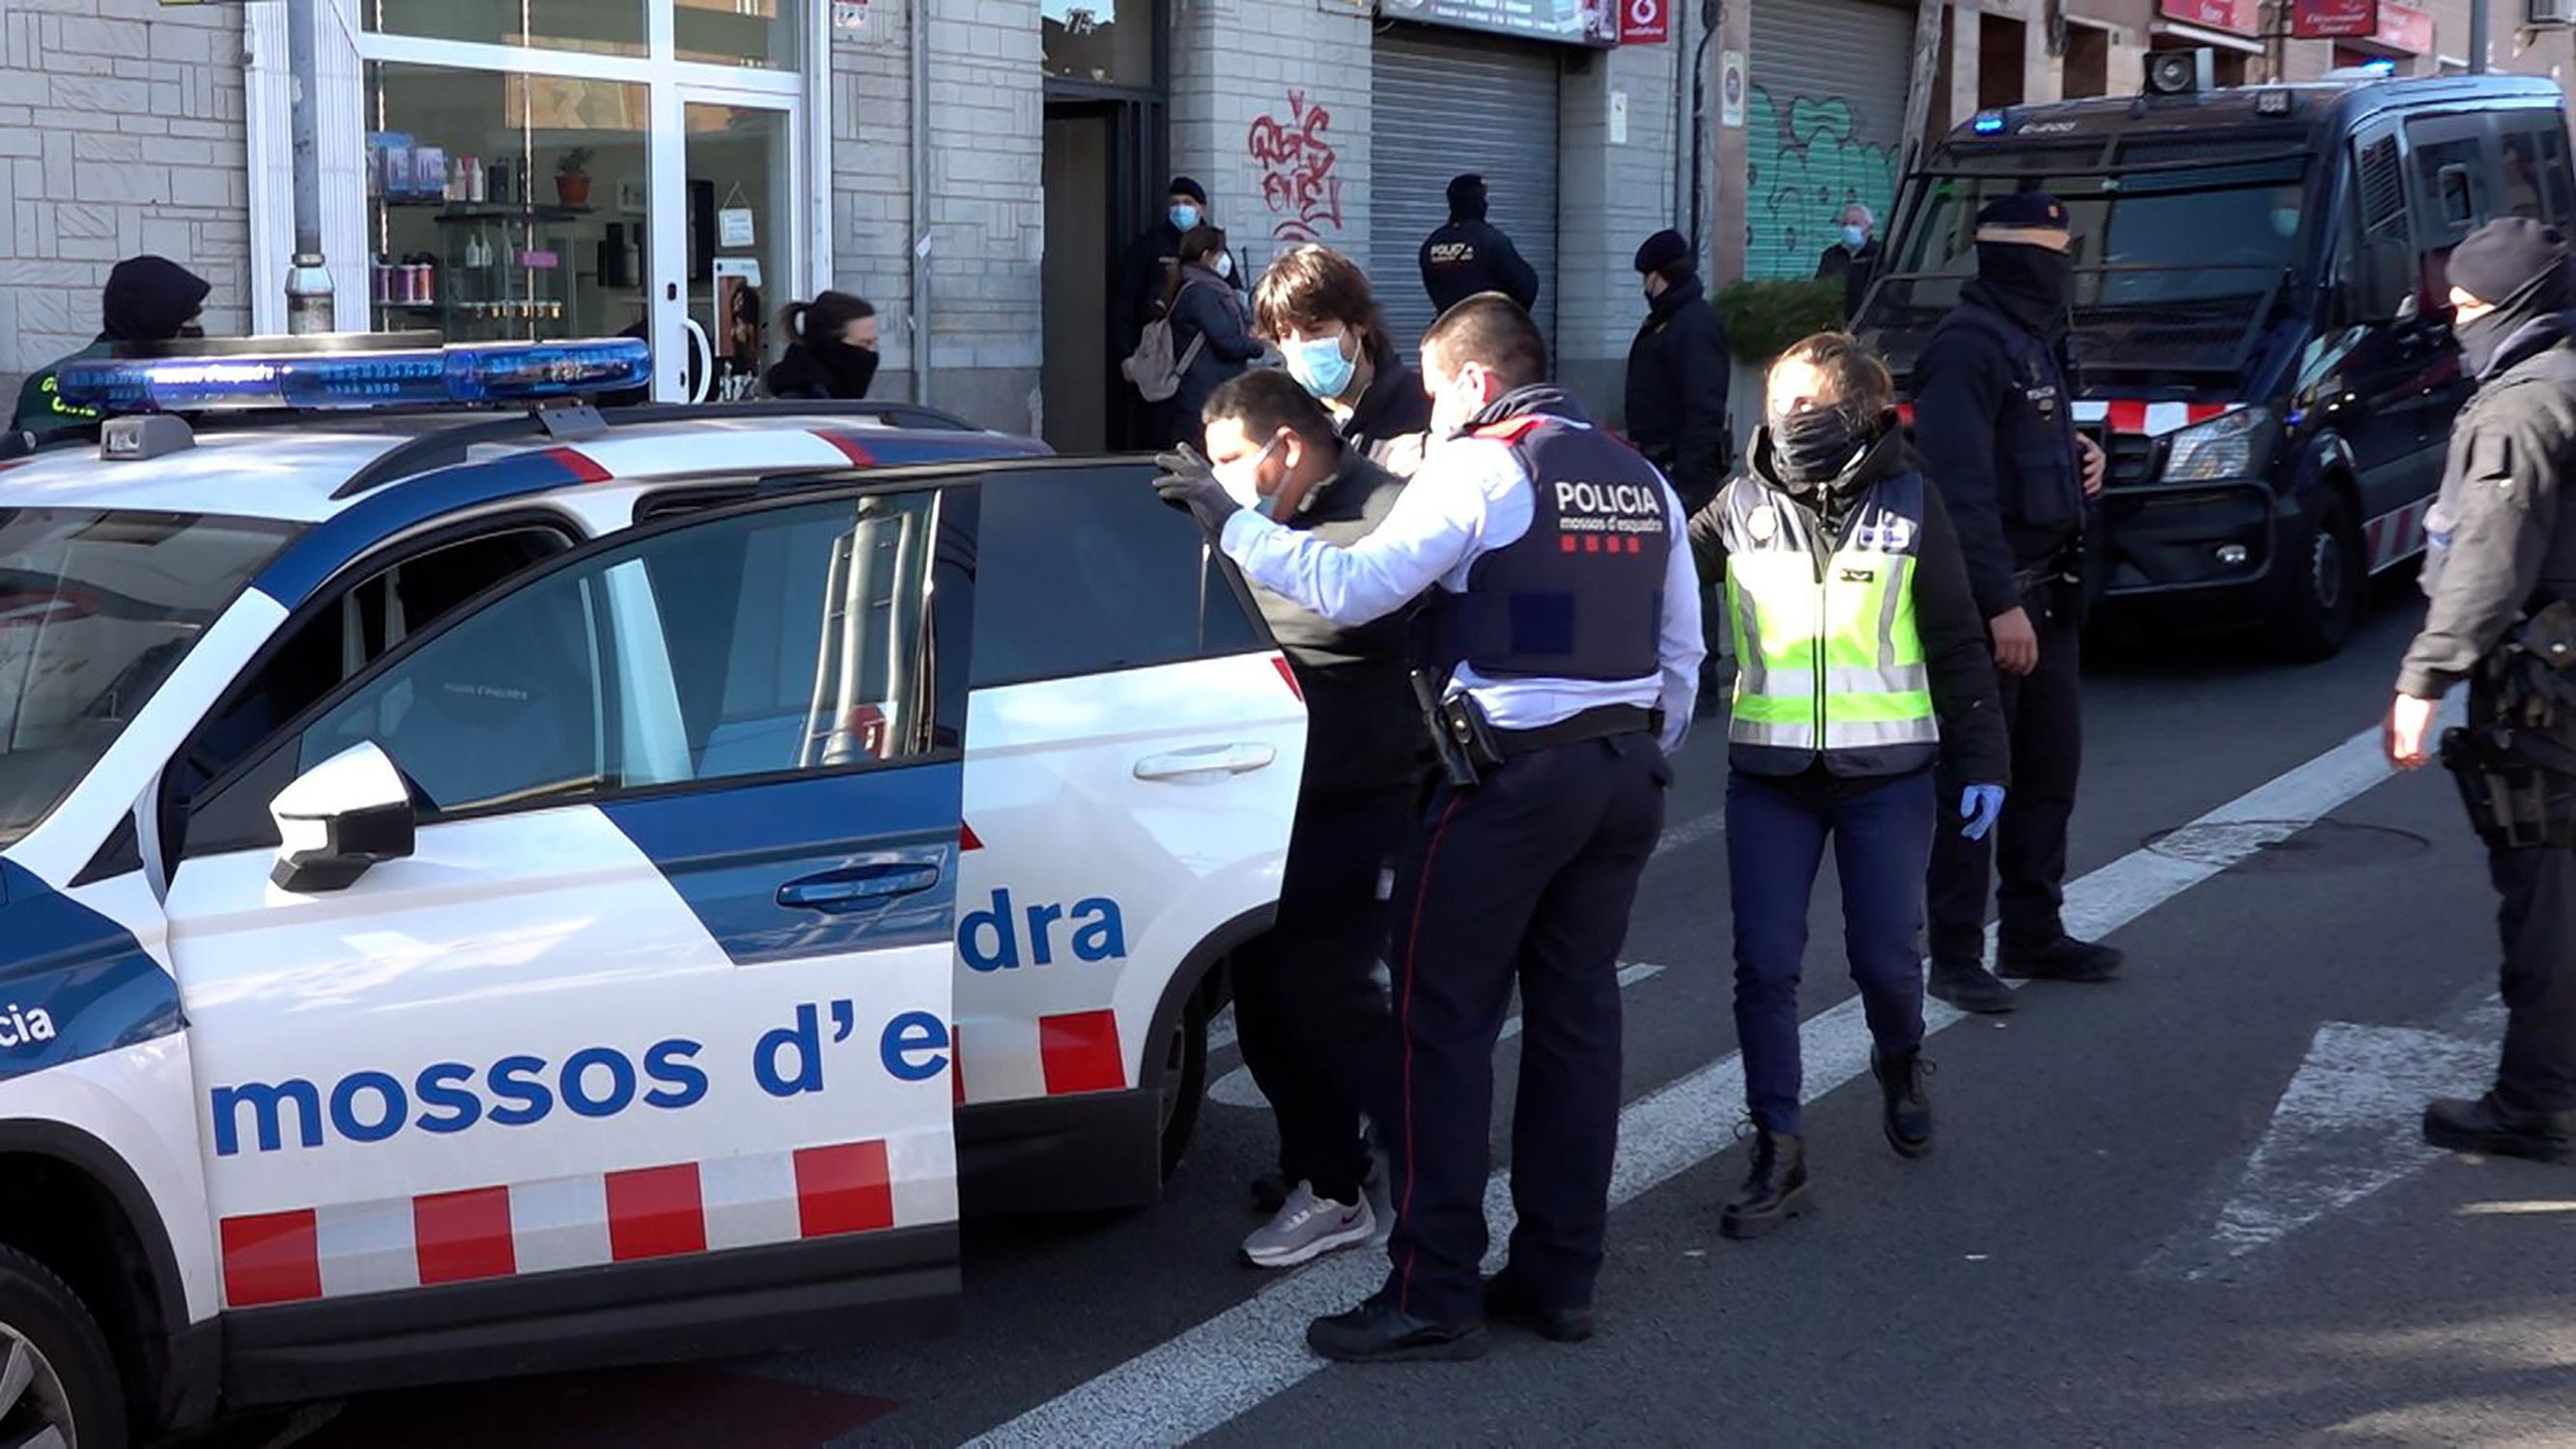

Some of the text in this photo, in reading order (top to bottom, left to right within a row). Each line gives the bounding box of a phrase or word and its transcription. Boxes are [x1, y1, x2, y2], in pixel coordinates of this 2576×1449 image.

[1554, 481, 1660, 514] POLICIA
[957, 887, 1127, 973] dra
[210, 1037, 709, 1156] mossos
